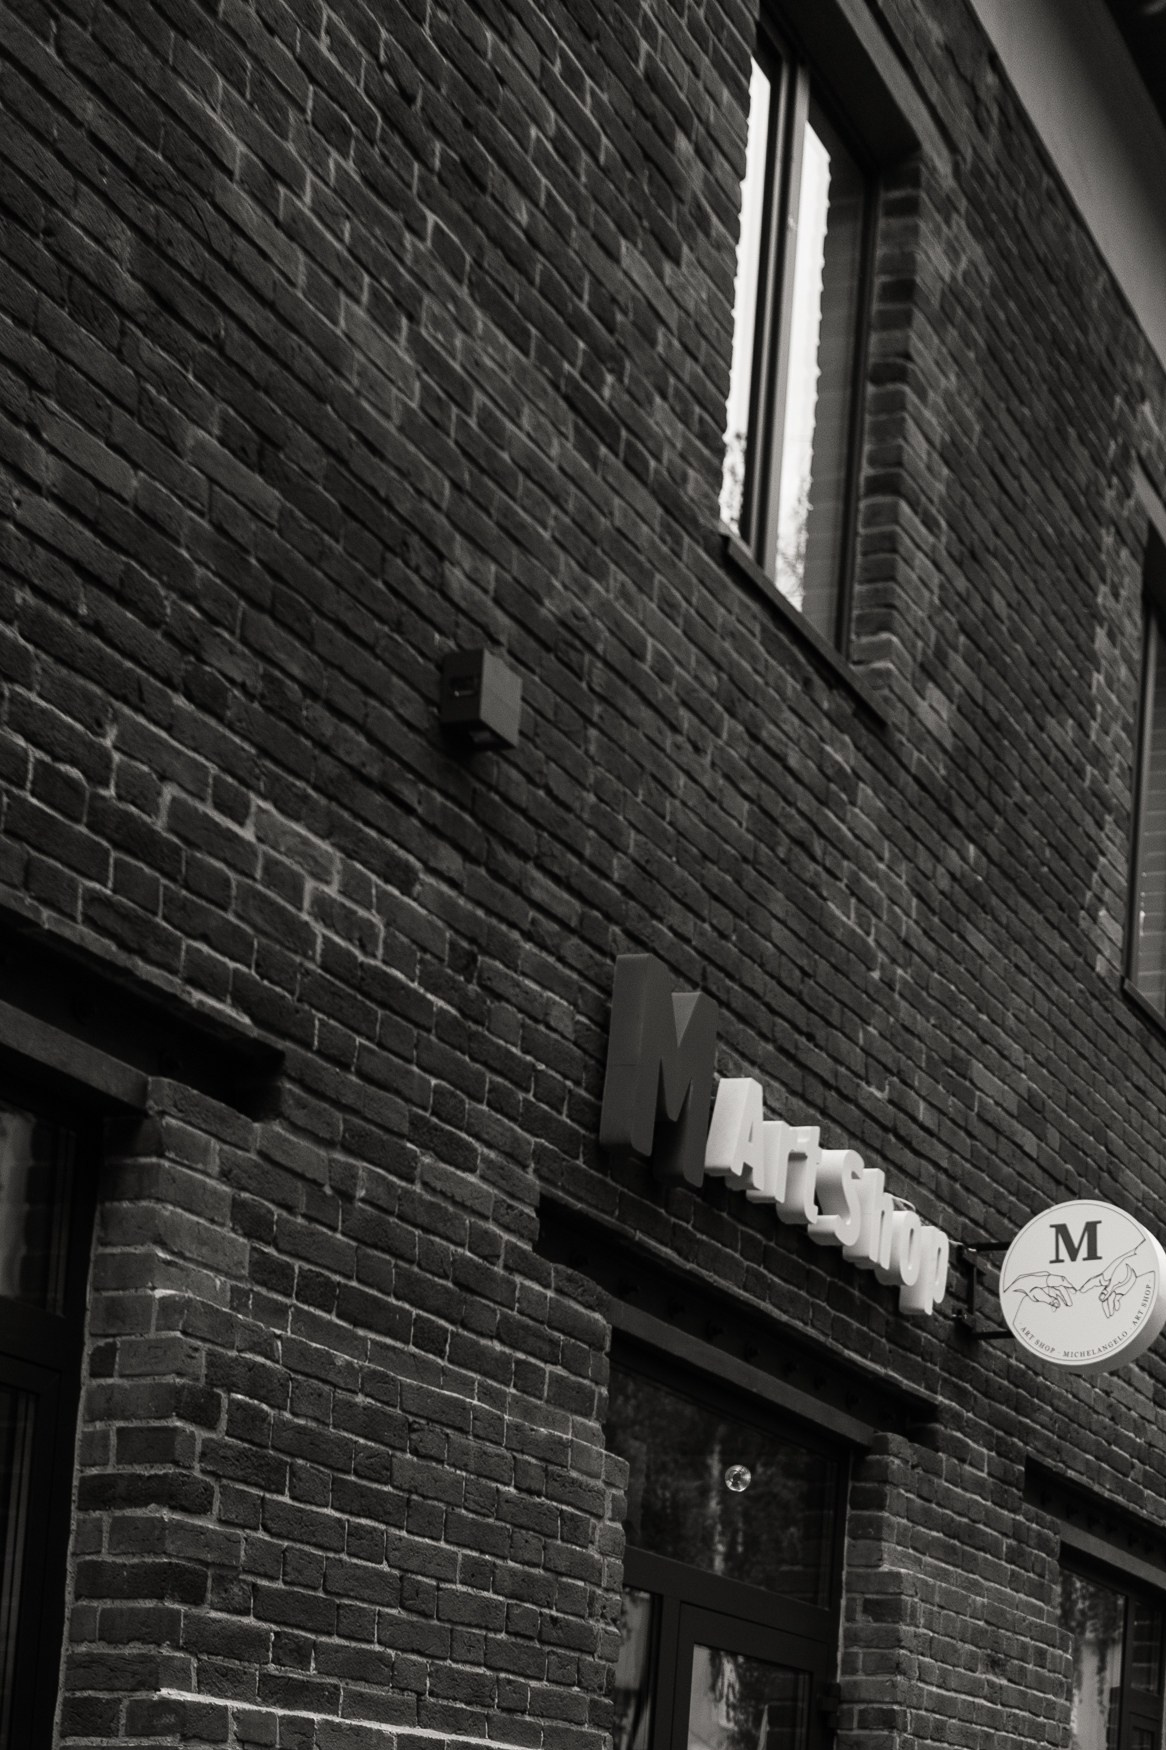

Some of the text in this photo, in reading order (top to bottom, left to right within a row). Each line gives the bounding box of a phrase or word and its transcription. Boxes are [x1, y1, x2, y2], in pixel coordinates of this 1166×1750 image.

[599, 952, 719, 1188] M
[1048, 1219, 1104, 1265] M
[1019, 1284, 1153, 1359] ART SHOP MICHELANGELO ART SHOP
